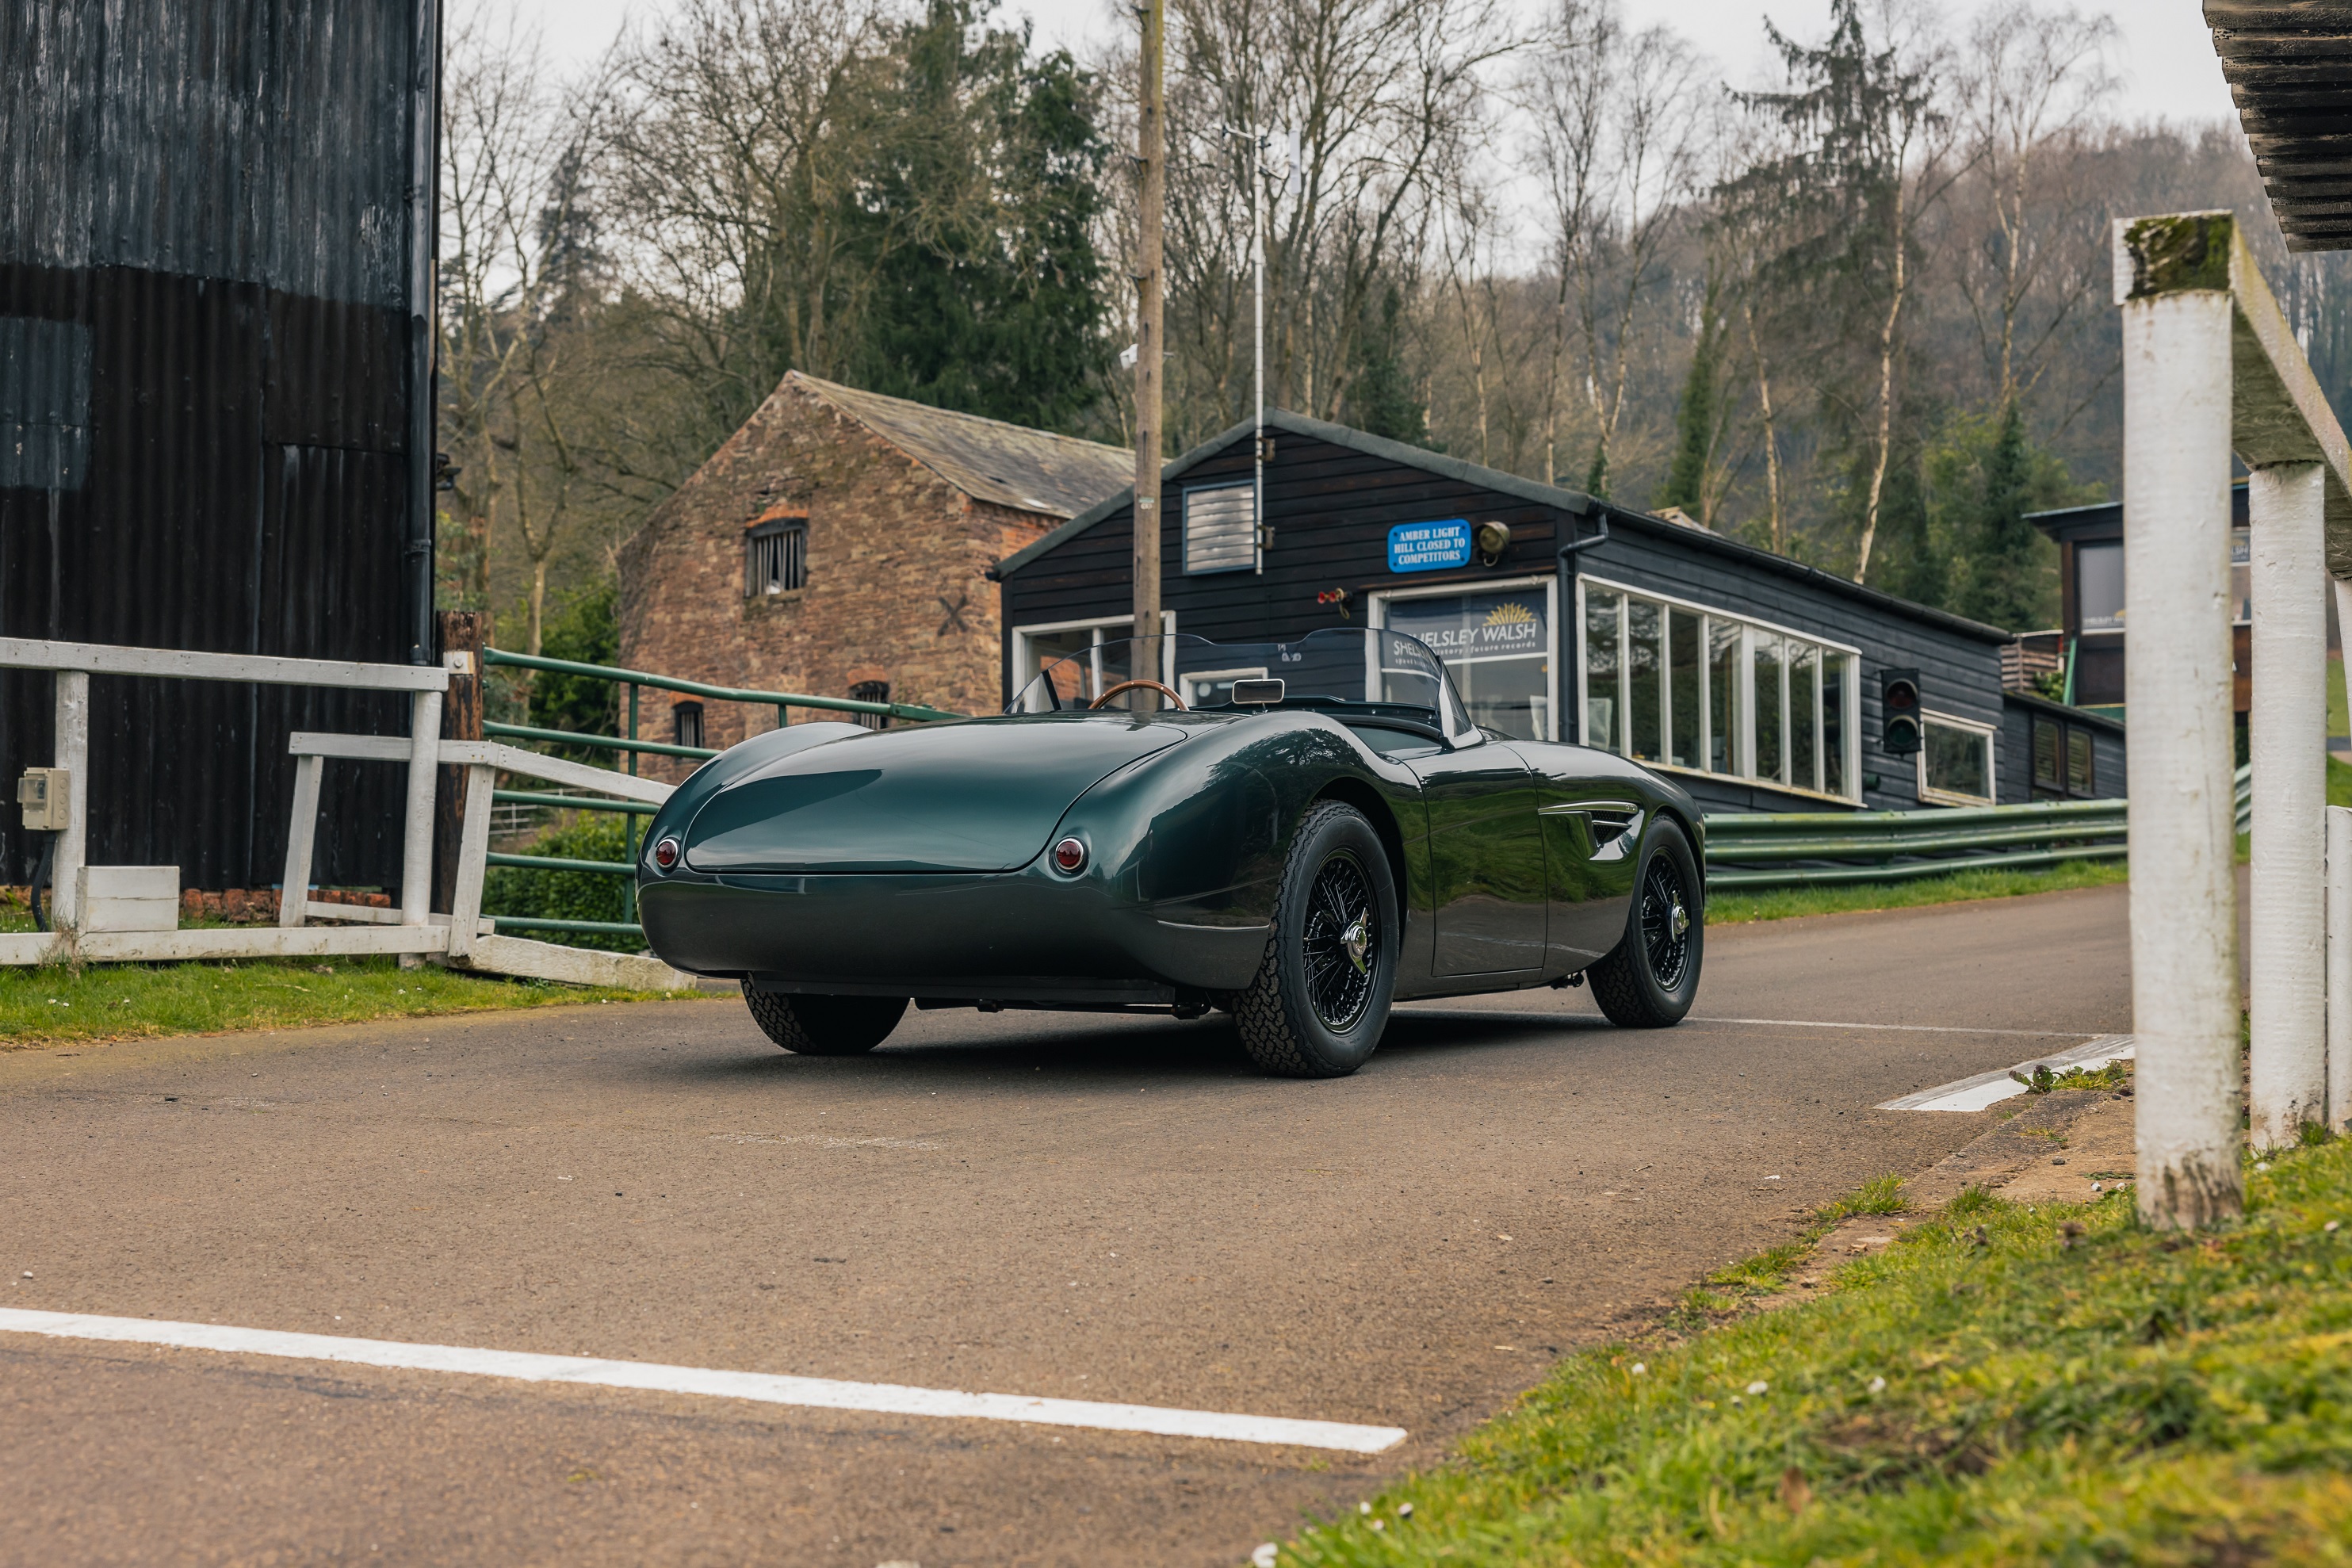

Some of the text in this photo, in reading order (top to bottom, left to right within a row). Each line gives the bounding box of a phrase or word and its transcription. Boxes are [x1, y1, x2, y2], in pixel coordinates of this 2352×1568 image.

[1399, 526, 1460, 541] AMBER LIGHT
[1394, 537, 1465, 553] HILL CLOSED TO
[1398, 550, 1461, 565] COMPETITORS
[1482, 622, 1537, 642] WALSH
[1470, 644, 1499, 653] future
[1501, 641, 1536, 650] records
